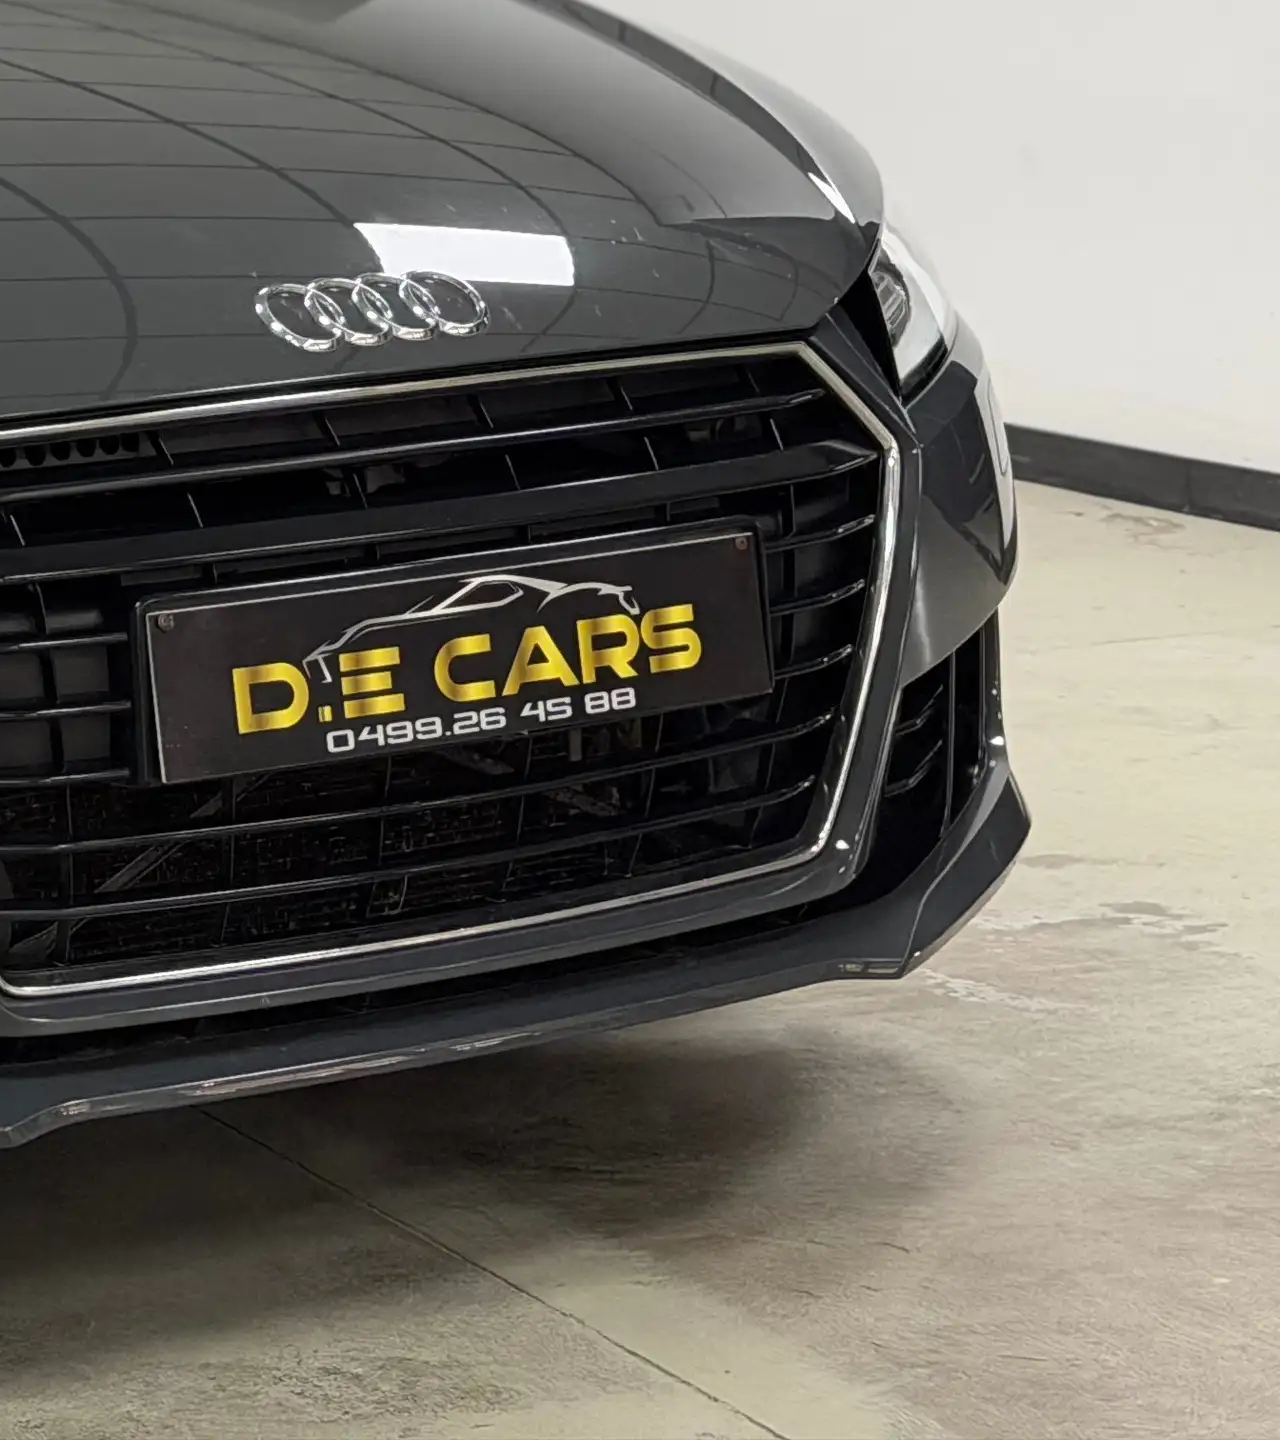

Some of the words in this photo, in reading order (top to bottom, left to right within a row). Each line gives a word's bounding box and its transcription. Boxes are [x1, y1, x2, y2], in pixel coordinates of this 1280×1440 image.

[232, 646, 407, 735] D.E
[433, 603, 703, 703] CARS
[326, 706, 507, 753] 0499.26
[520, 696, 573, 723] 45
[584, 687, 637, 714] 88
